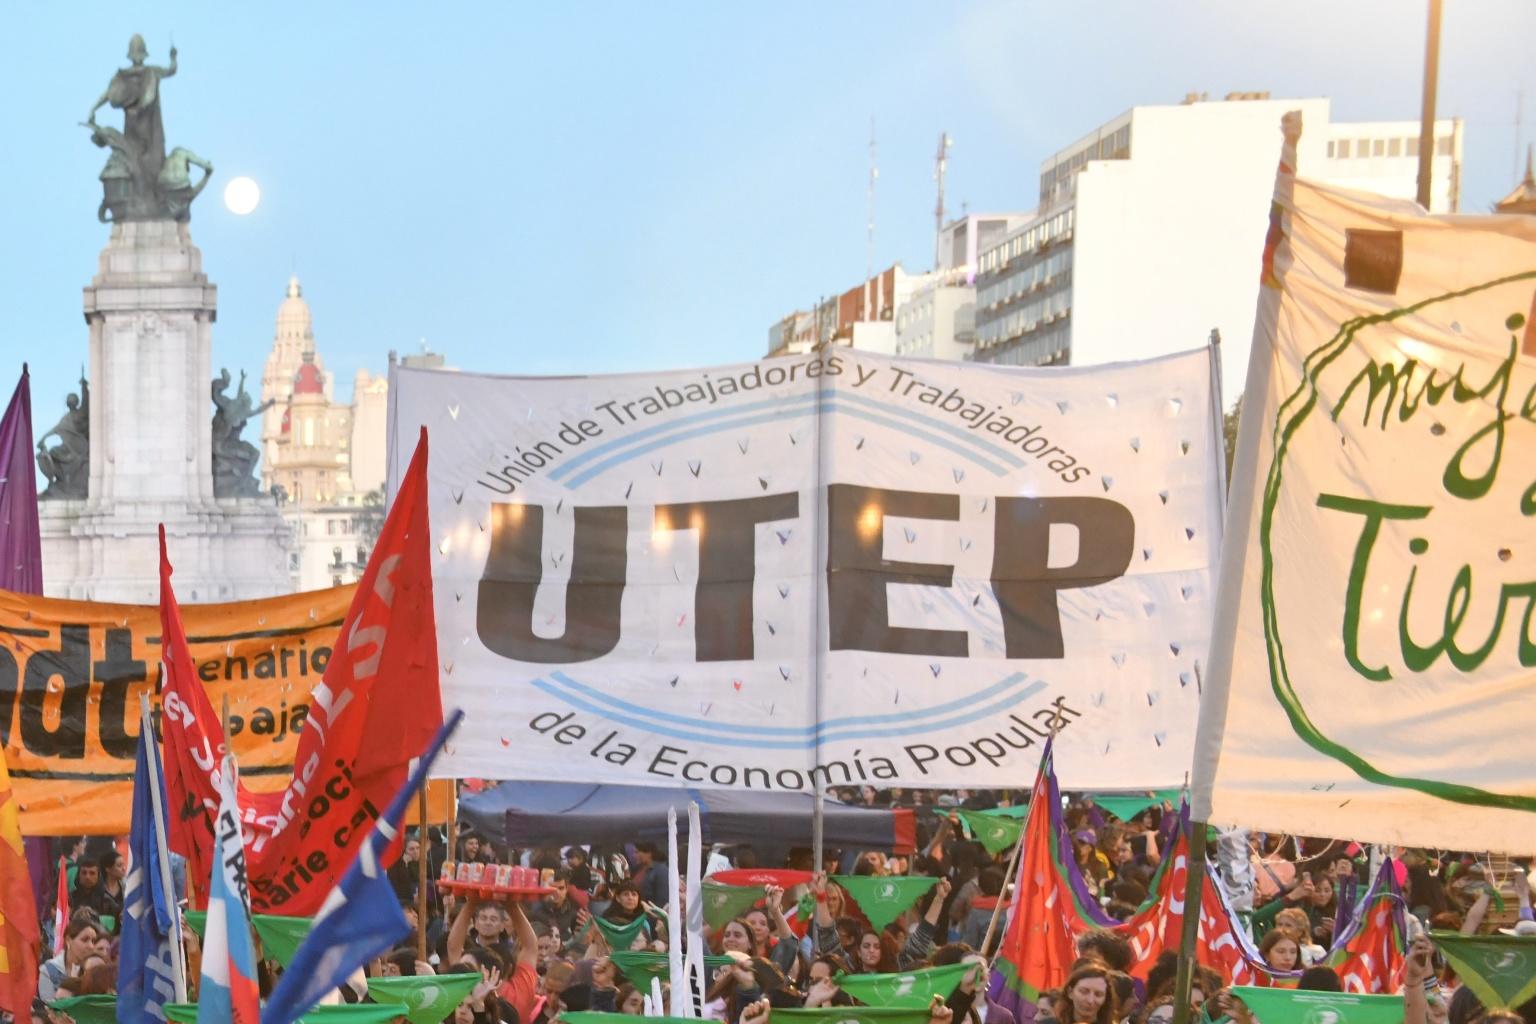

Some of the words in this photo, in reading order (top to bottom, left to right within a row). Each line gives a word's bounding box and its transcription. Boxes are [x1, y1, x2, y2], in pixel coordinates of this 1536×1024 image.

[477, 437, 564, 495] Unión
[557, 420, 604, 447] de
[595, 355, 843, 427] Trabajadores
[852, 363, 877, 387] y
[889, 366, 1091, 484] Trabajadoras
[1331, 312, 1536, 500] muj
[476, 484, 1135, 664] UTEP
[529, 706, 587, 746] de
[595, 730, 638, 766] la
[646, 744, 899, 792] Economía
[904, 695, 1083, 775] Popular
